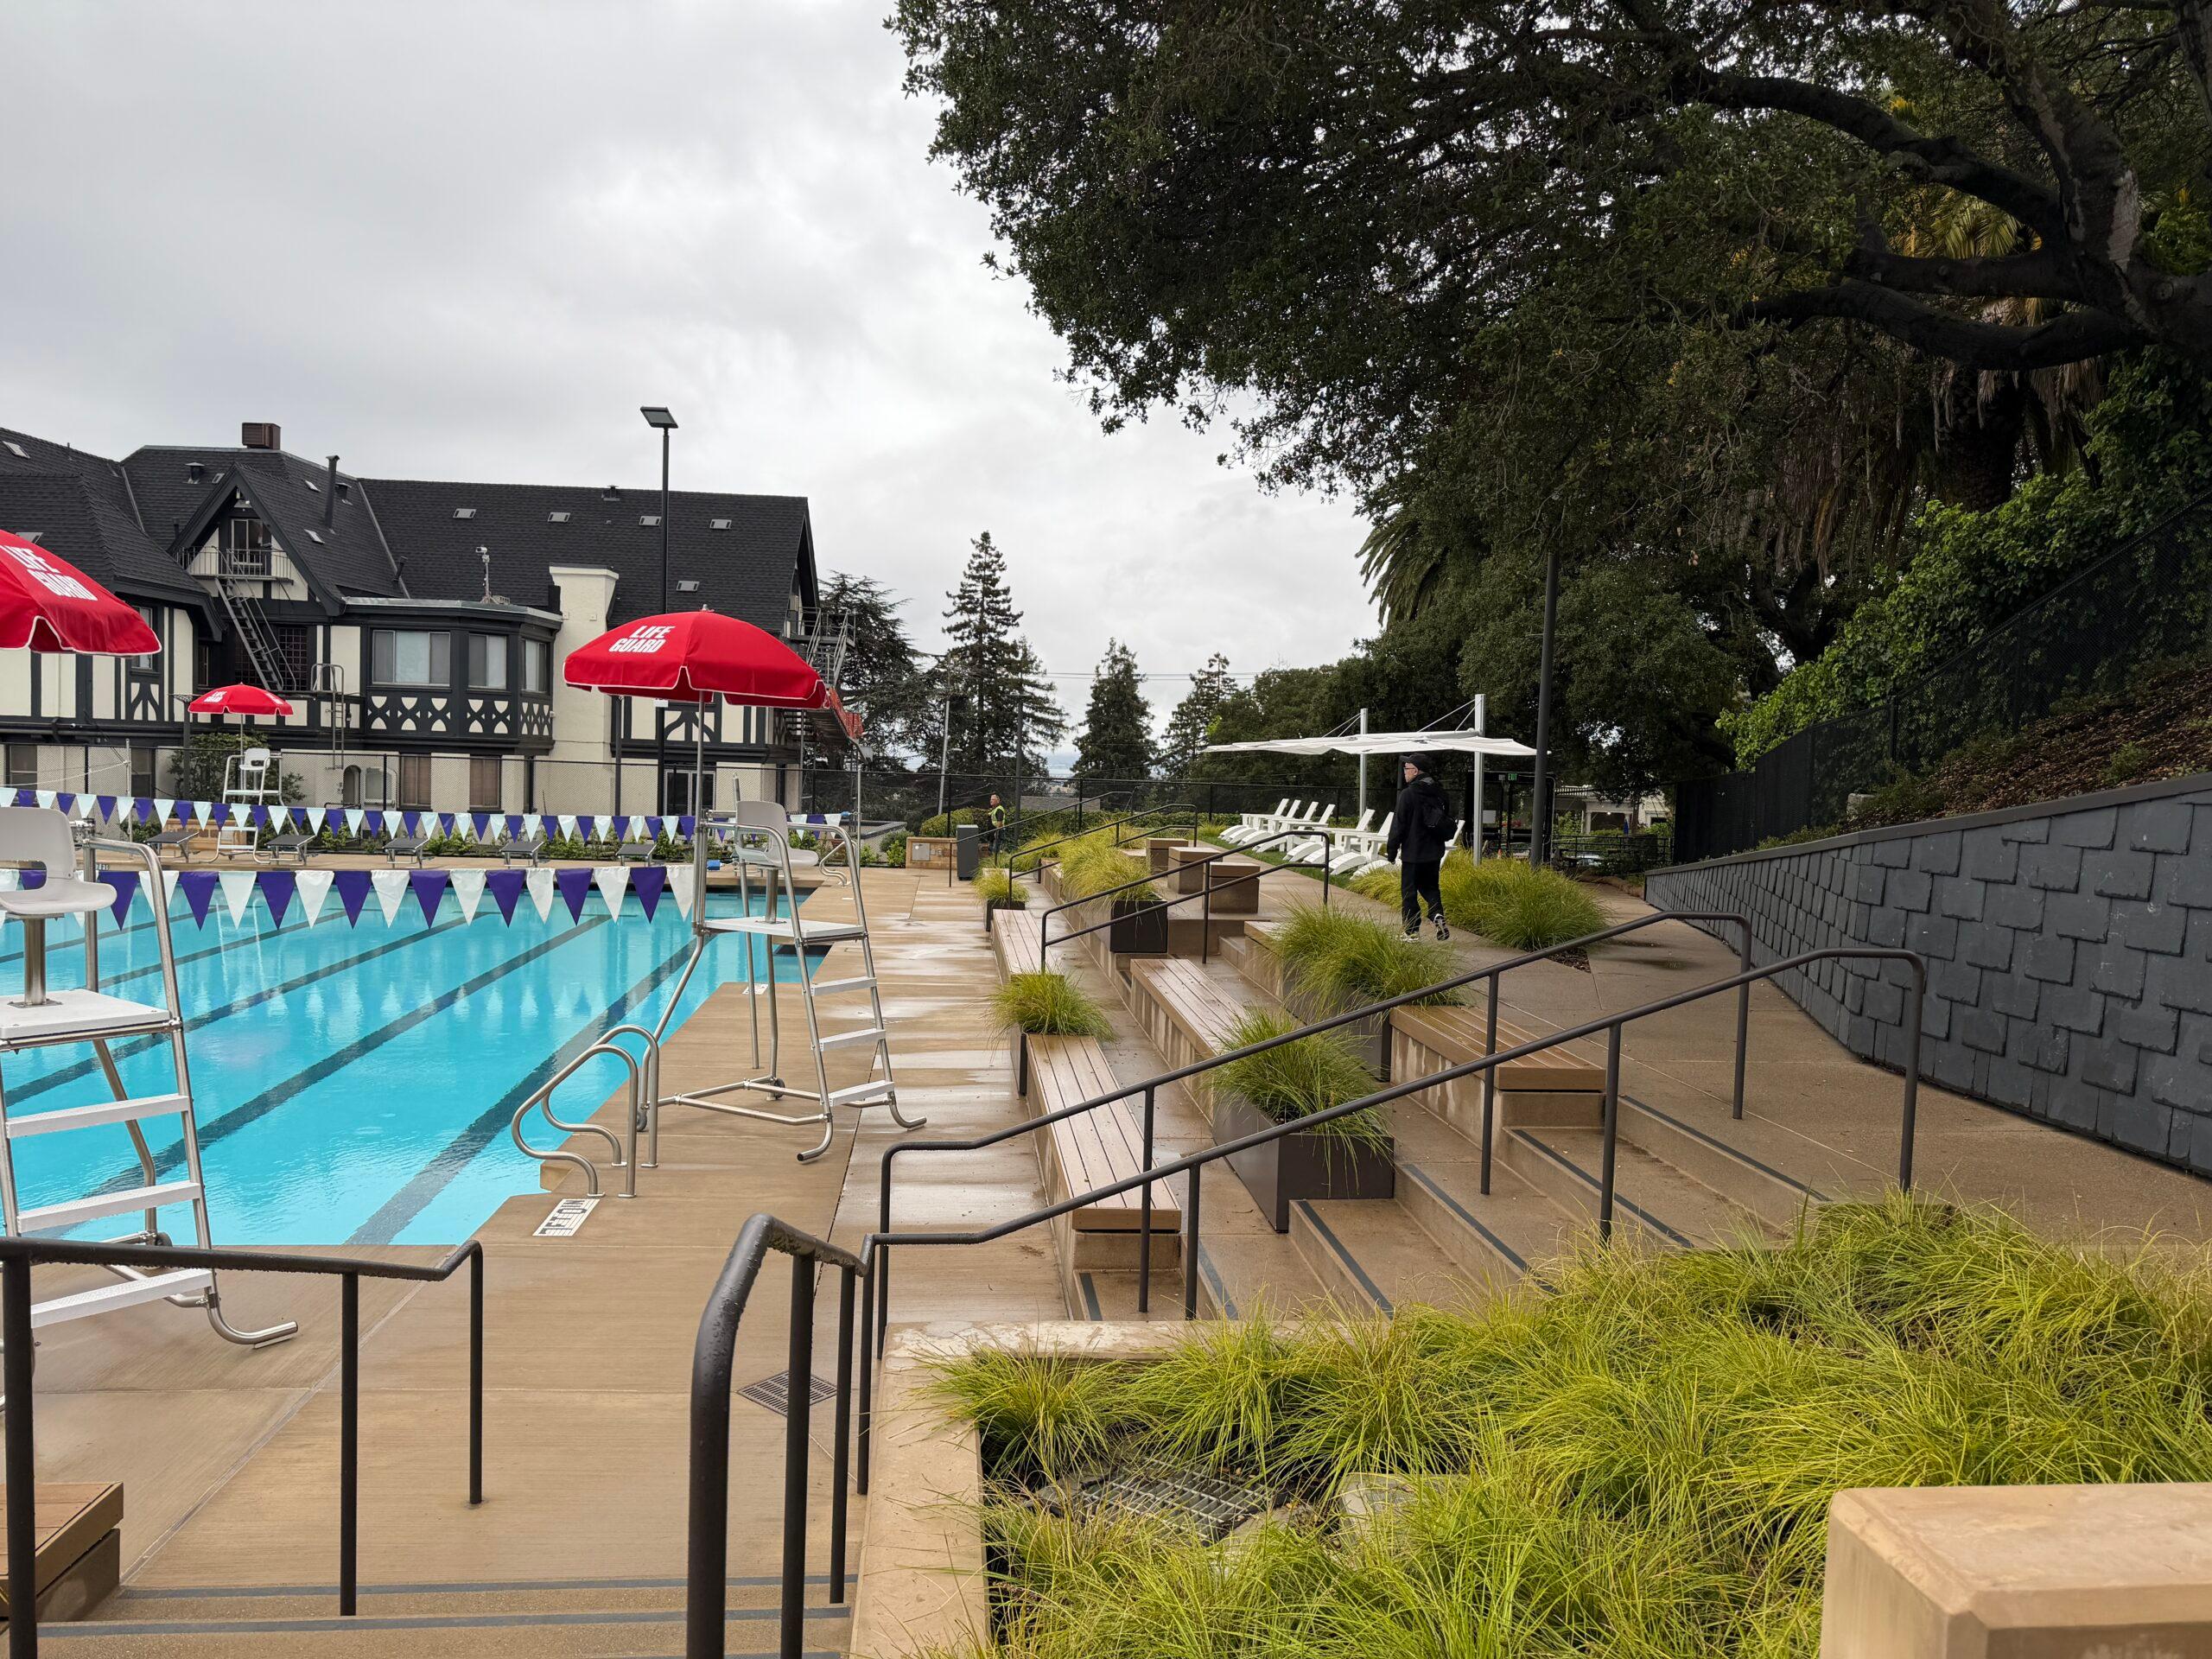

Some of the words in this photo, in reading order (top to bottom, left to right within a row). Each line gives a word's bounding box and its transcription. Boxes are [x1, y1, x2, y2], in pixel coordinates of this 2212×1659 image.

[0, 545, 61, 574] LIFE
[27, 569, 98, 601] GUARD
[629, 626, 676, 639] LIFE
[608, 638, 666, 653] GUARD
